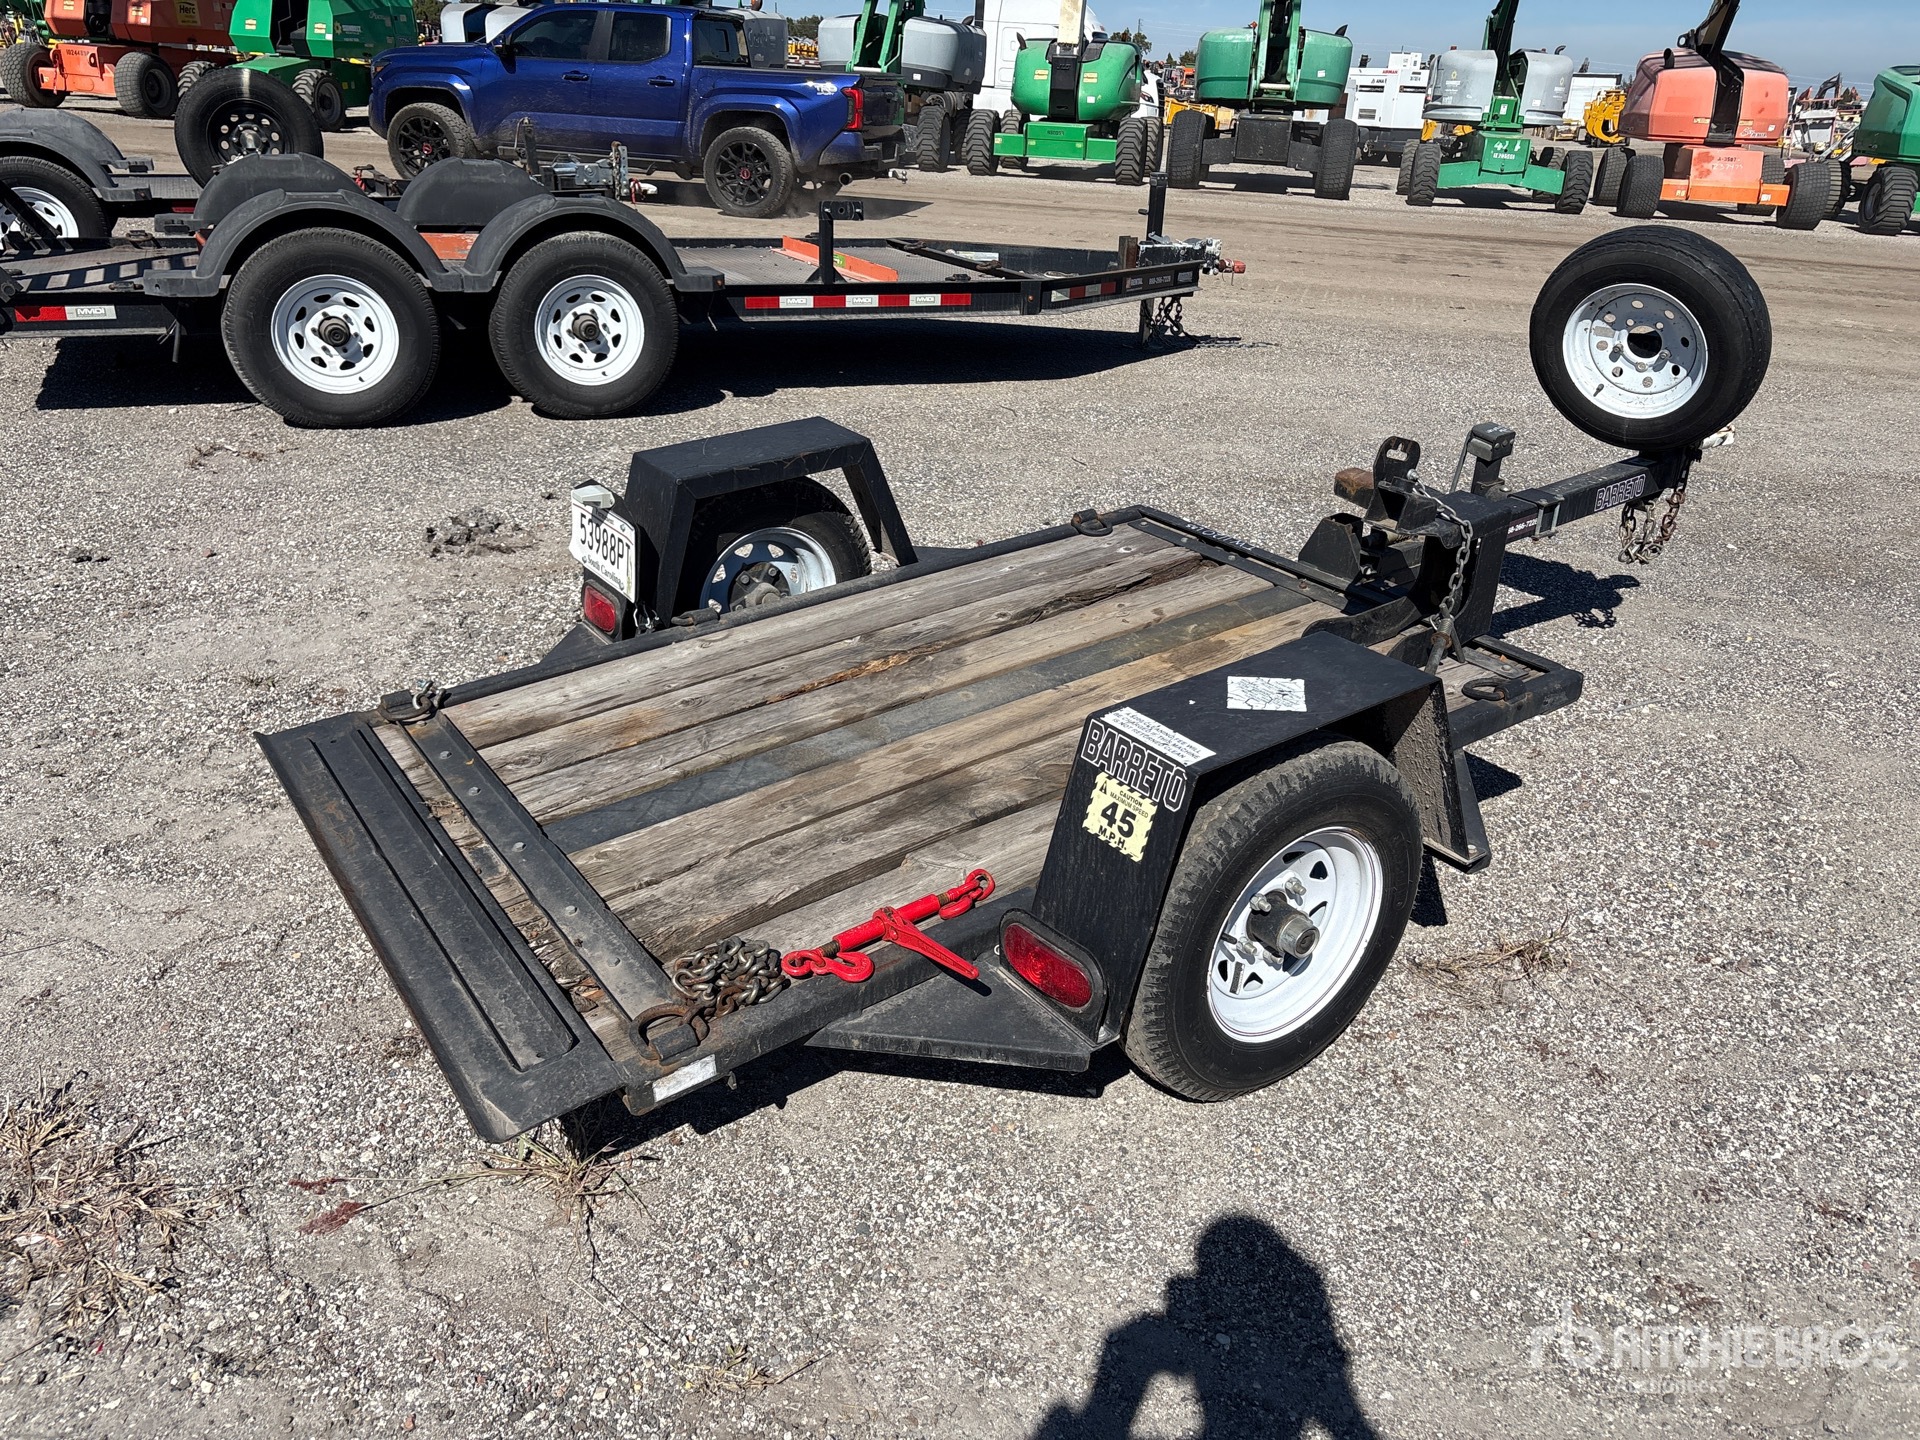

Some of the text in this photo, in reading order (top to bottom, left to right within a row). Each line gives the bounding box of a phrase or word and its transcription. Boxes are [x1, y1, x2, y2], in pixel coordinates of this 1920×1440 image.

[179, 5, 195, 14] Herc
[814, 82, 837, 93] TRD
[1594, 474, 1646, 512] BARRETO
[580, 513, 630, 577] 53988PT
[1081, 719, 1187, 812] BARRETO
[1110, 792, 1148, 818] MAXIMUM SPEED
[1120, 790, 1143, 807] CAUTION
[1101, 802, 1137, 838] 45
[1098, 825, 1127, 850] M.P.H.
